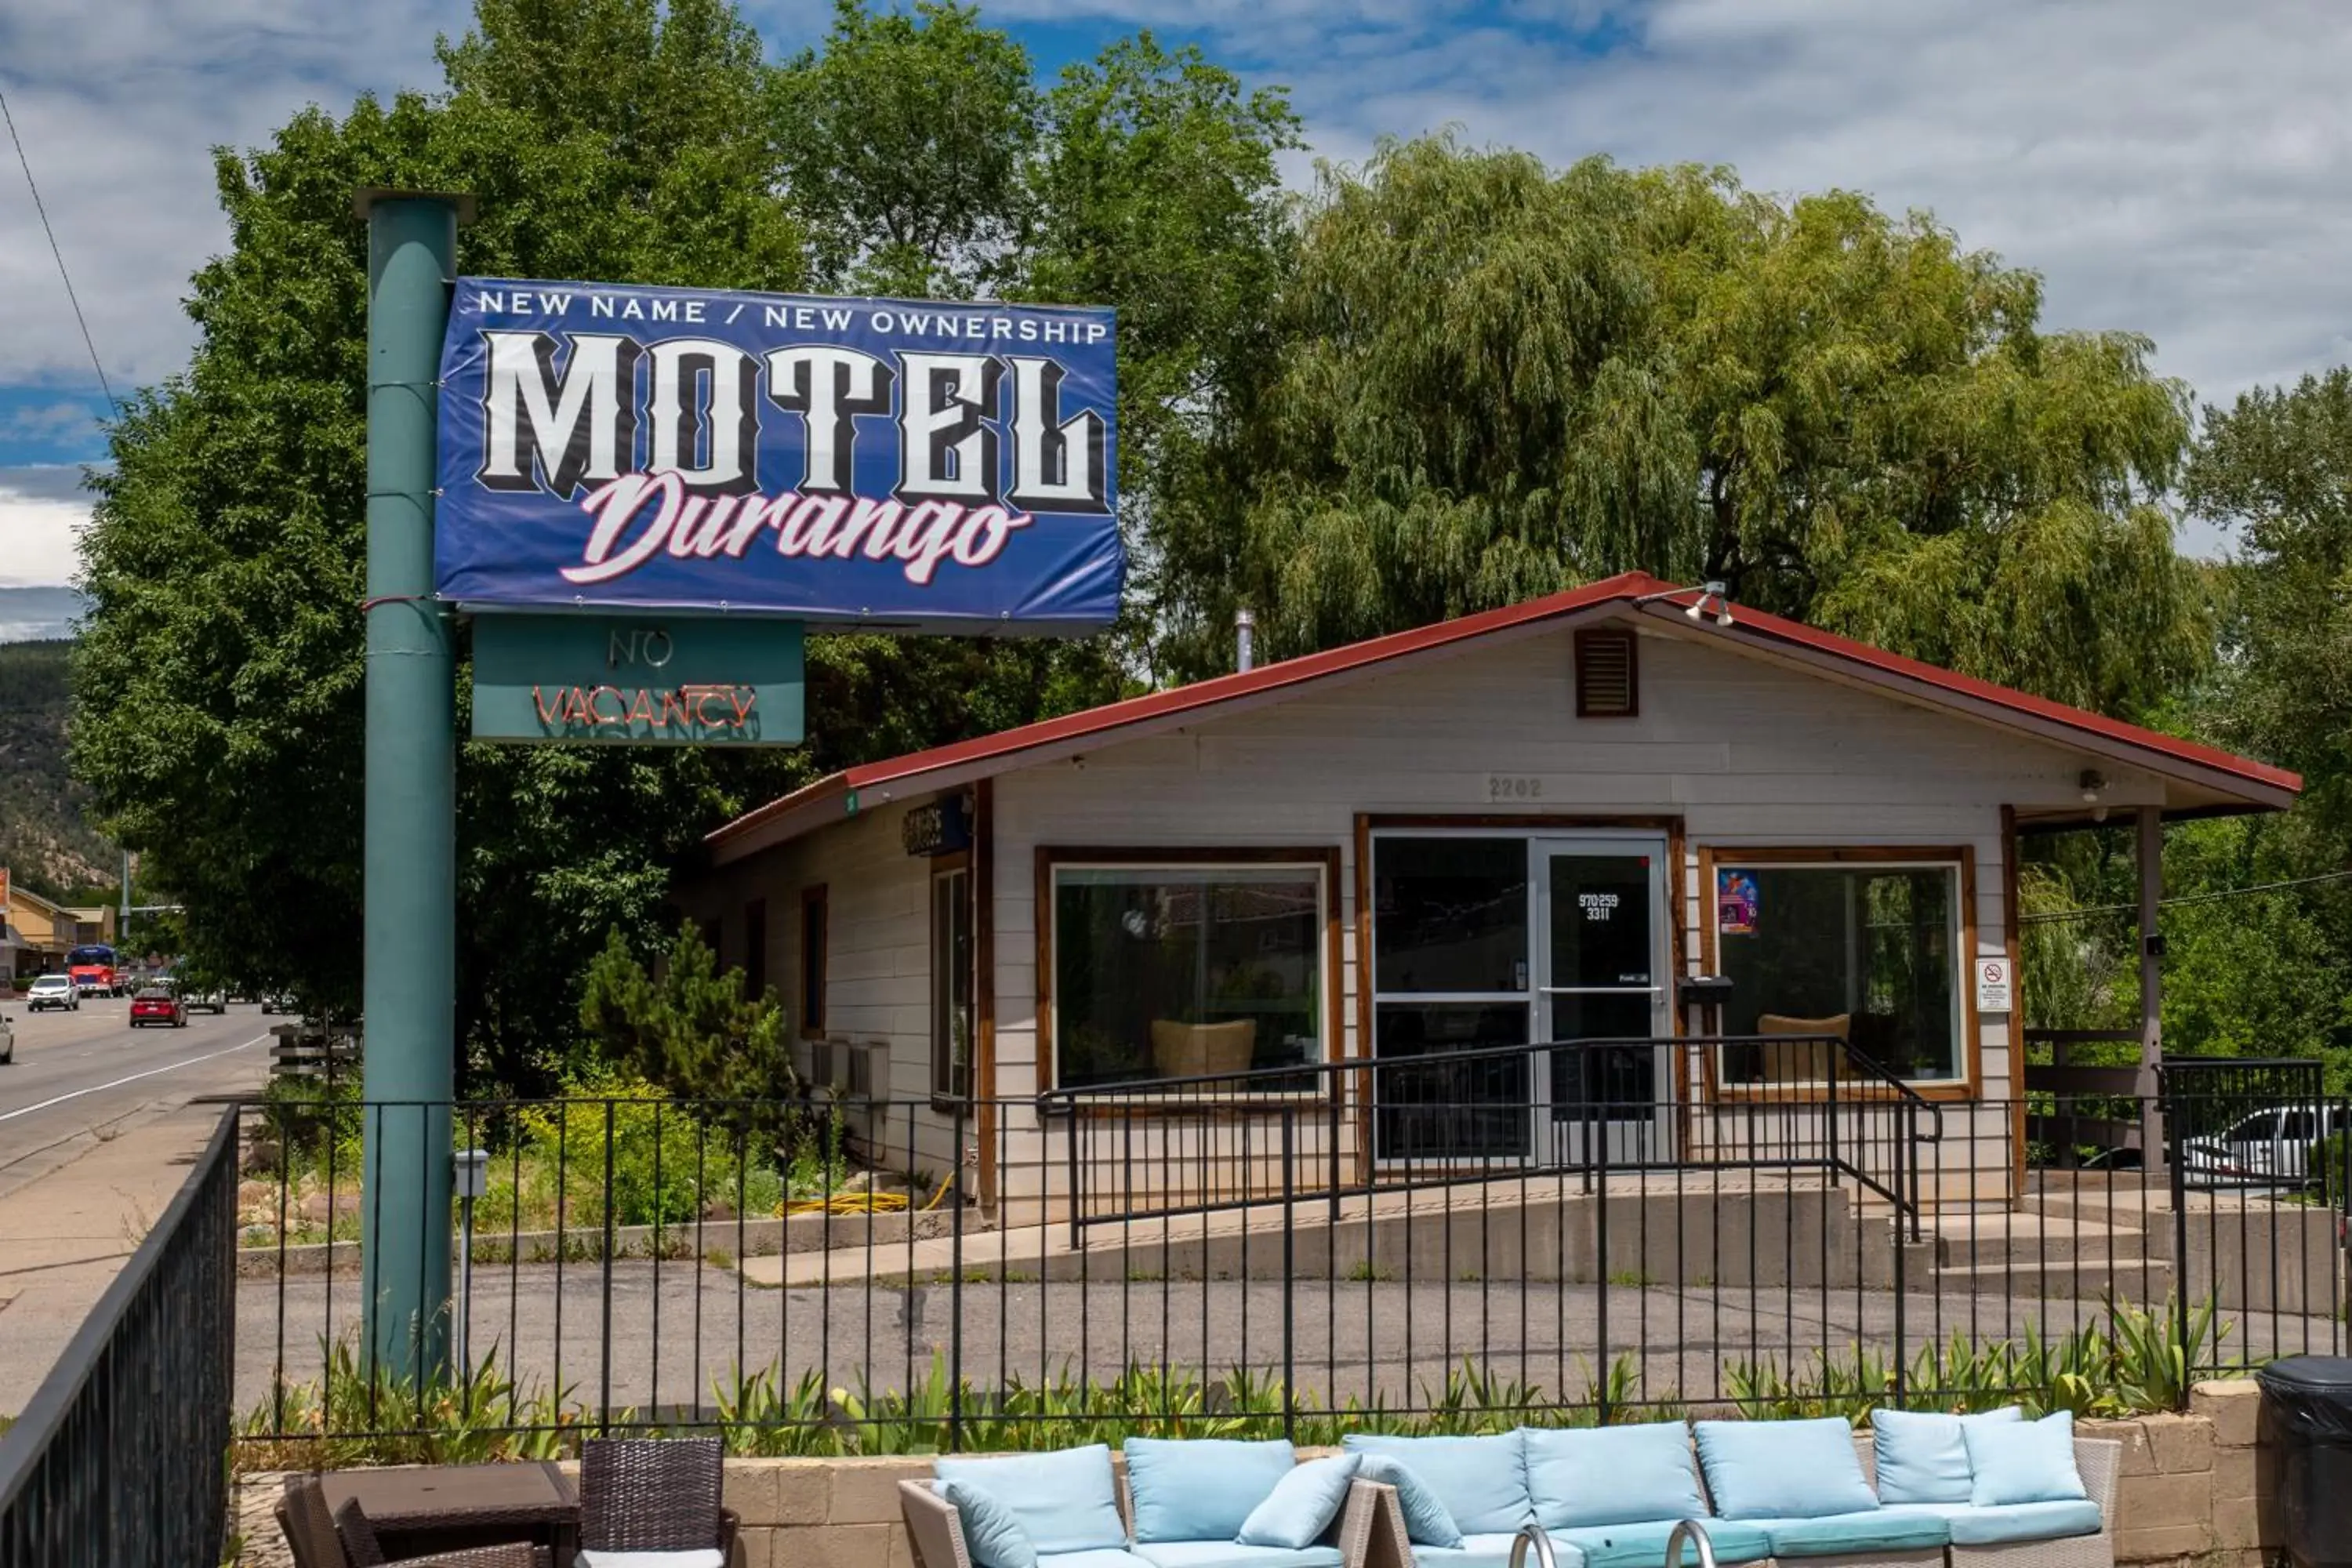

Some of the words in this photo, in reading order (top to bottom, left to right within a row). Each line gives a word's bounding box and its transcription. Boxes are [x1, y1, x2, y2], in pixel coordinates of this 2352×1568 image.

[481, 292, 571, 315] NEW
[591, 296, 706, 322] NAME
[765, 306, 851, 330] NEW
[871, 311, 1106, 344] OWNERSHIP
[474, 330, 1113, 514] MOTEL
[560, 470, 1033, 585] Durango
[608, 630, 673, 666] NO
[532, 684, 755, 728] VACANCY
[1587, 907, 1610, 920] 3311
